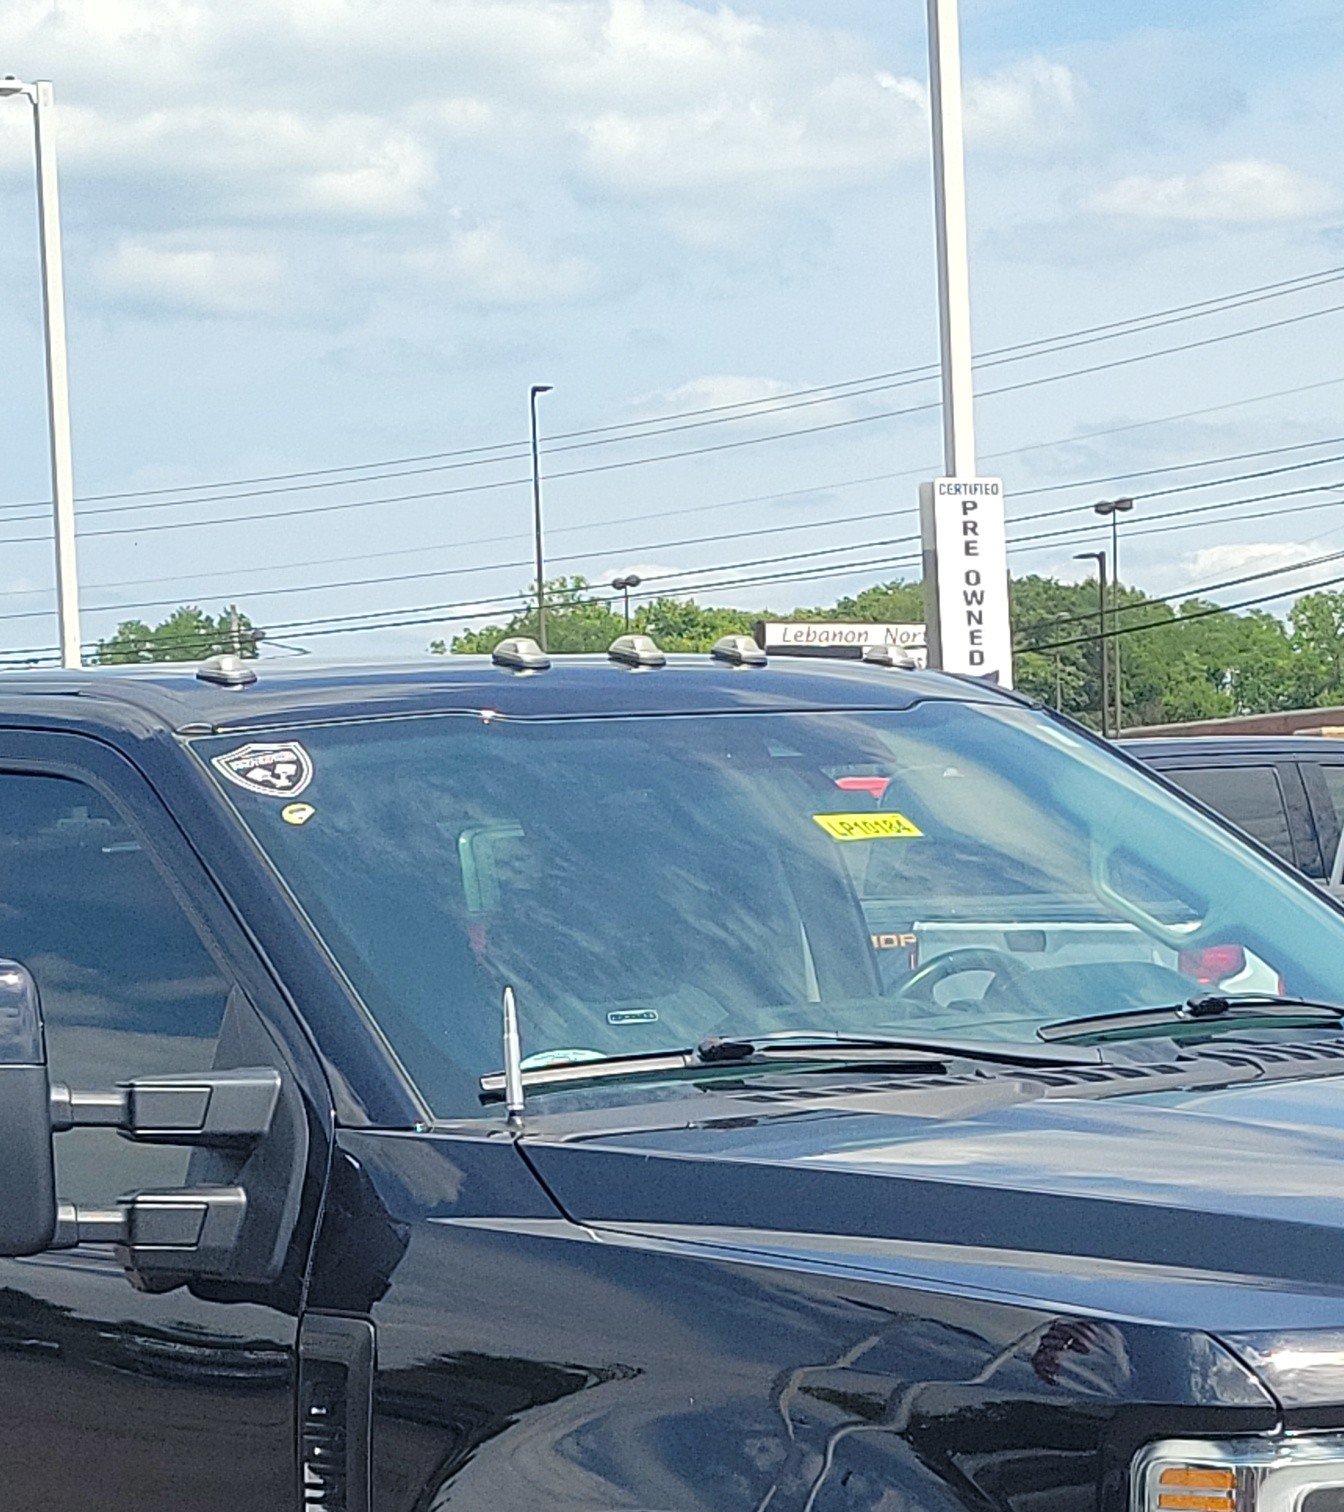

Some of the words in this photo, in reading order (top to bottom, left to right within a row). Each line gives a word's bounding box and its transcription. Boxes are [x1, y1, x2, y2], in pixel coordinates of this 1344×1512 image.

[939, 483, 999, 496] CERTIFIED
[961, 500, 979, 556] PRE
[782, 626, 869, 643] Lebanon
[885, 626, 927, 645] Nor
[963, 569, 985, 666] OWNED
